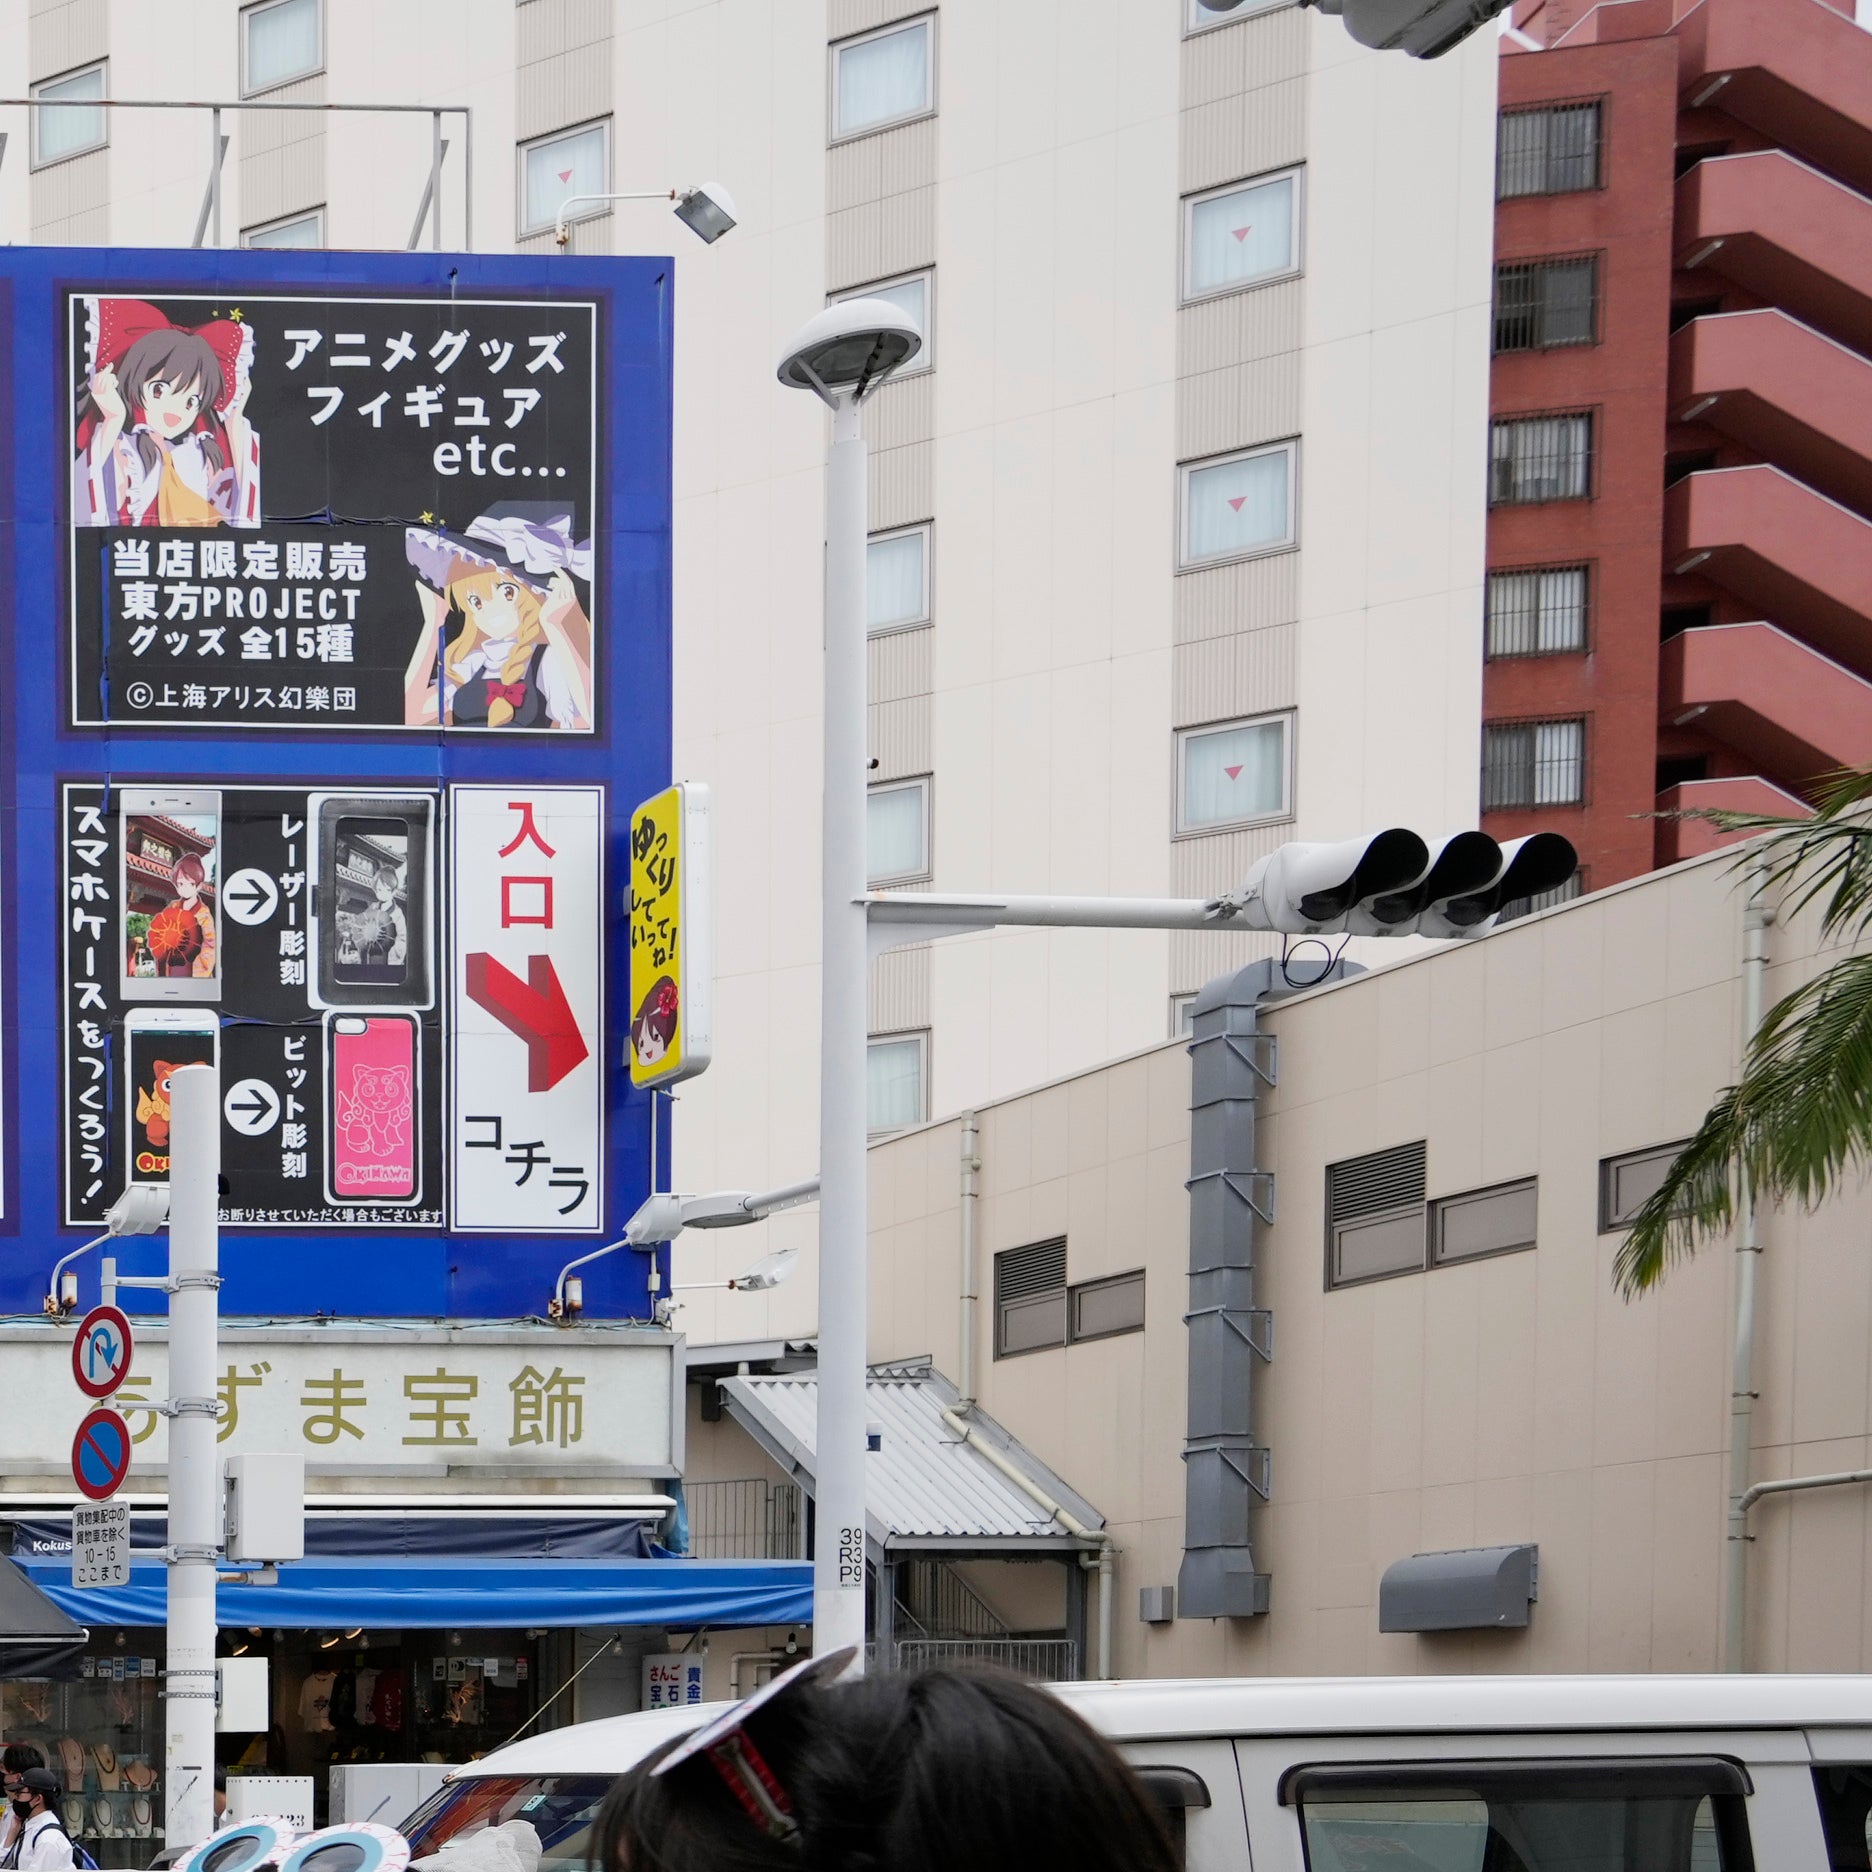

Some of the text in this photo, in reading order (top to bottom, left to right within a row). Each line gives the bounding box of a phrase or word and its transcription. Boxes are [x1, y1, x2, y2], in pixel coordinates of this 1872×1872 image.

[282, 329, 566, 374] アニメグッズ
[306, 384, 542, 428] フィギュア
[433, 435, 566, 478] etc...
[112, 538, 368, 582] 当店限定販売
[119, 581, 363, 622] 東方PROJECT
[127, 623, 355, 663] グッズ 全15種
[498, 800, 557, 930] 入口
[278, 813, 306, 986] レーザー彫刻
[280, 1036, 307, 1179] ビット彫刻
[463, 1115, 590, 1216] コチラ
[75, 1527, 126, 1546] 貨物車を除く
[839, 1546, 863, 1564] R3
[840, 1527, 862, 1546] 39
[77, 1564, 123, 1584] ここまで
[839, 1565, 862, 1583] P9
[649, 1664, 681, 1682] さんご
